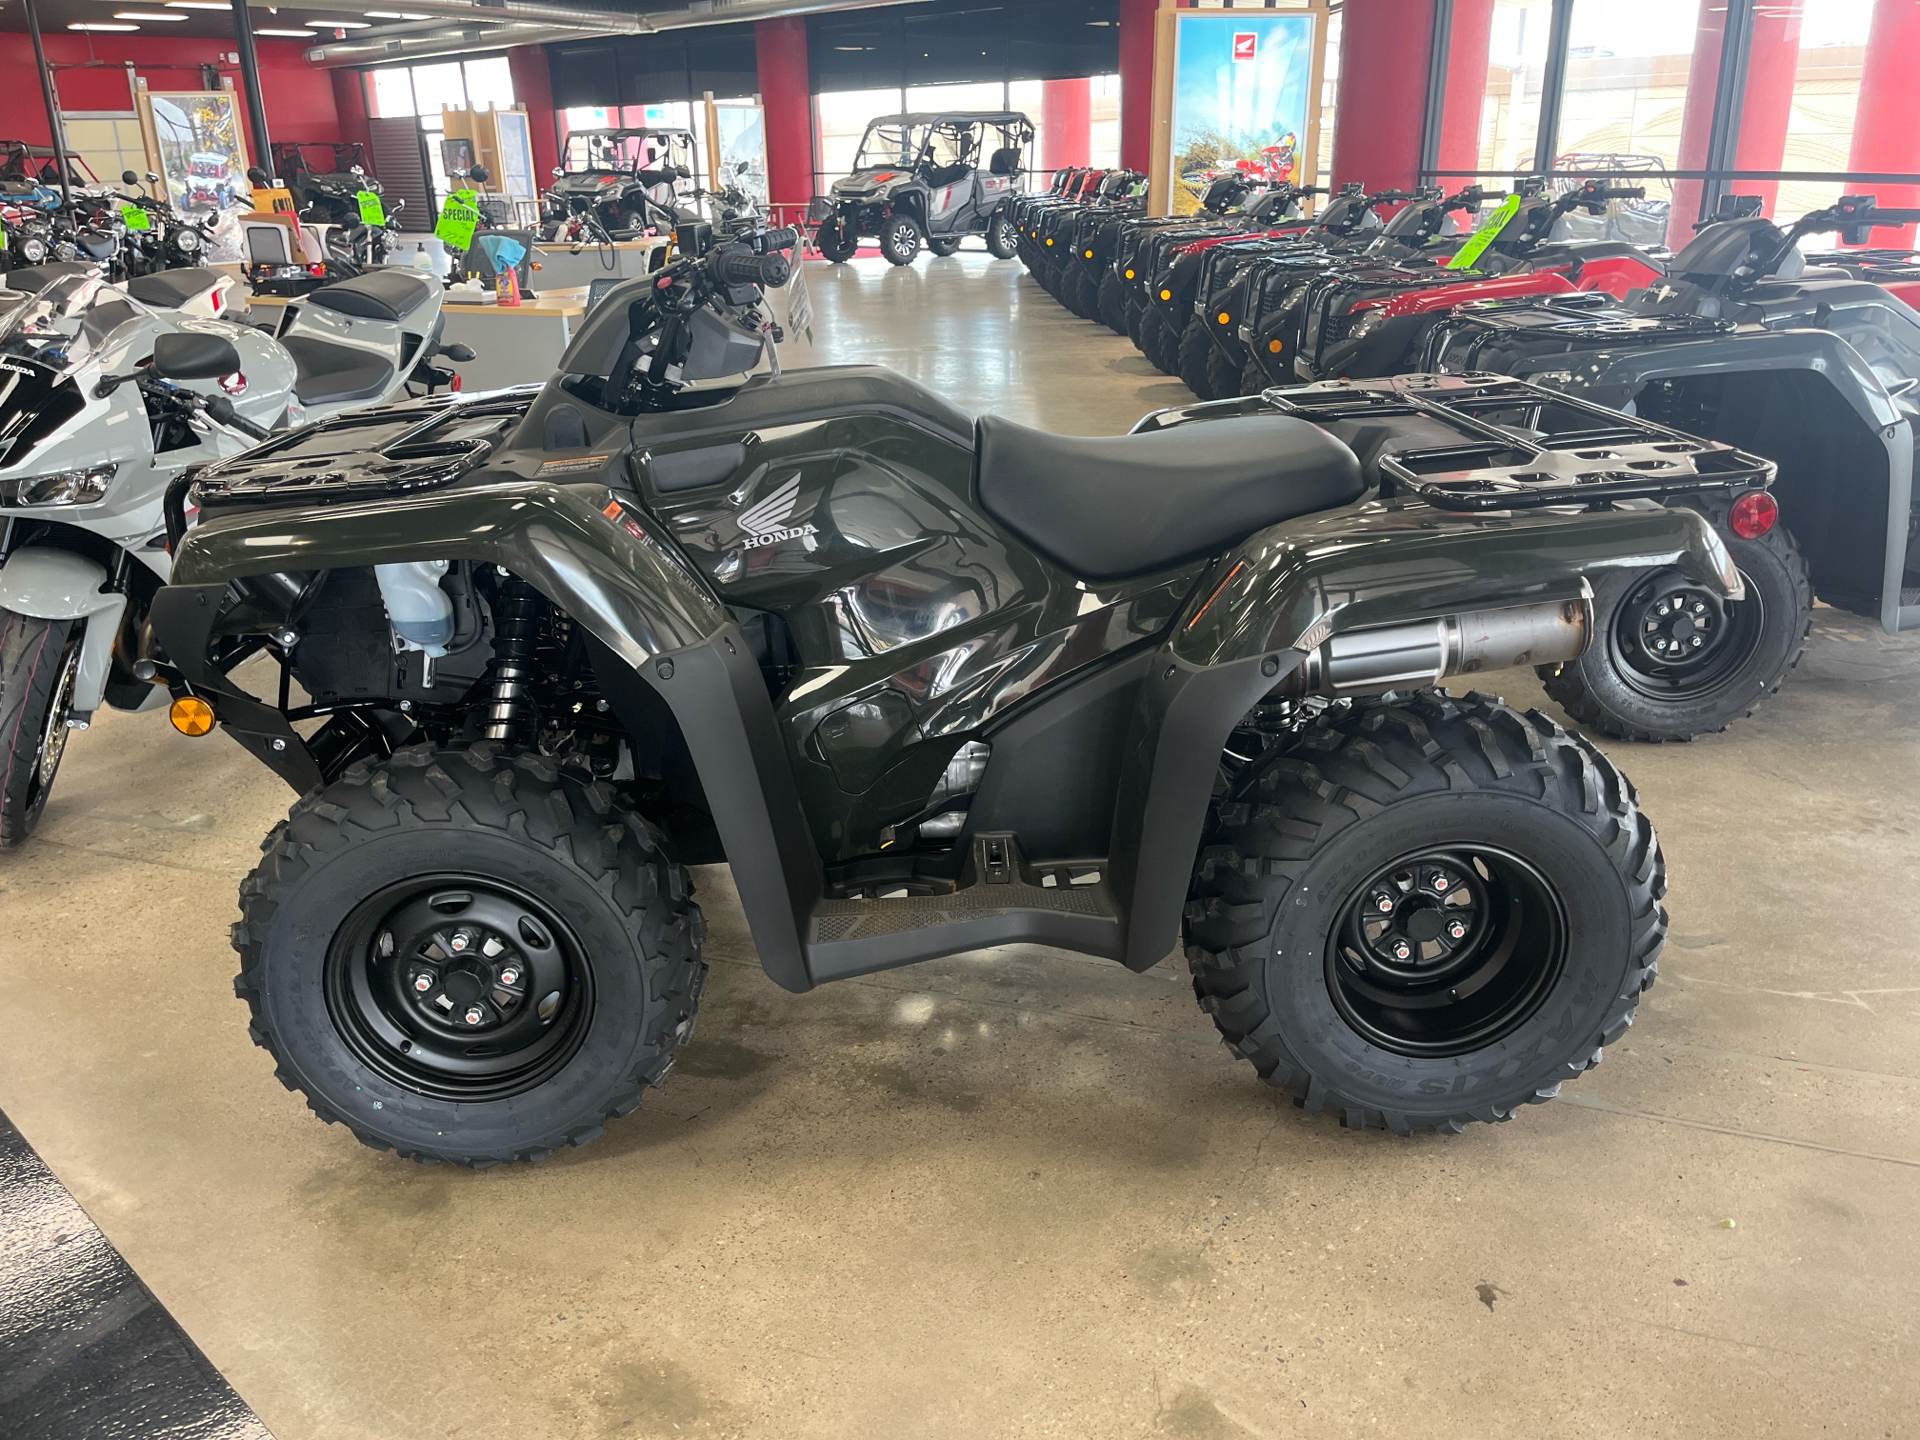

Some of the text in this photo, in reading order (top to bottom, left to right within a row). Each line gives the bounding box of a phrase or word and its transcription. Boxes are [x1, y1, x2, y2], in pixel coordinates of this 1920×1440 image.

[443, 208, 475, 222] SPECIAL
[742, 524, 820, 550] HONDA
[1415, 967, 1601, 1096] MAXXIS
